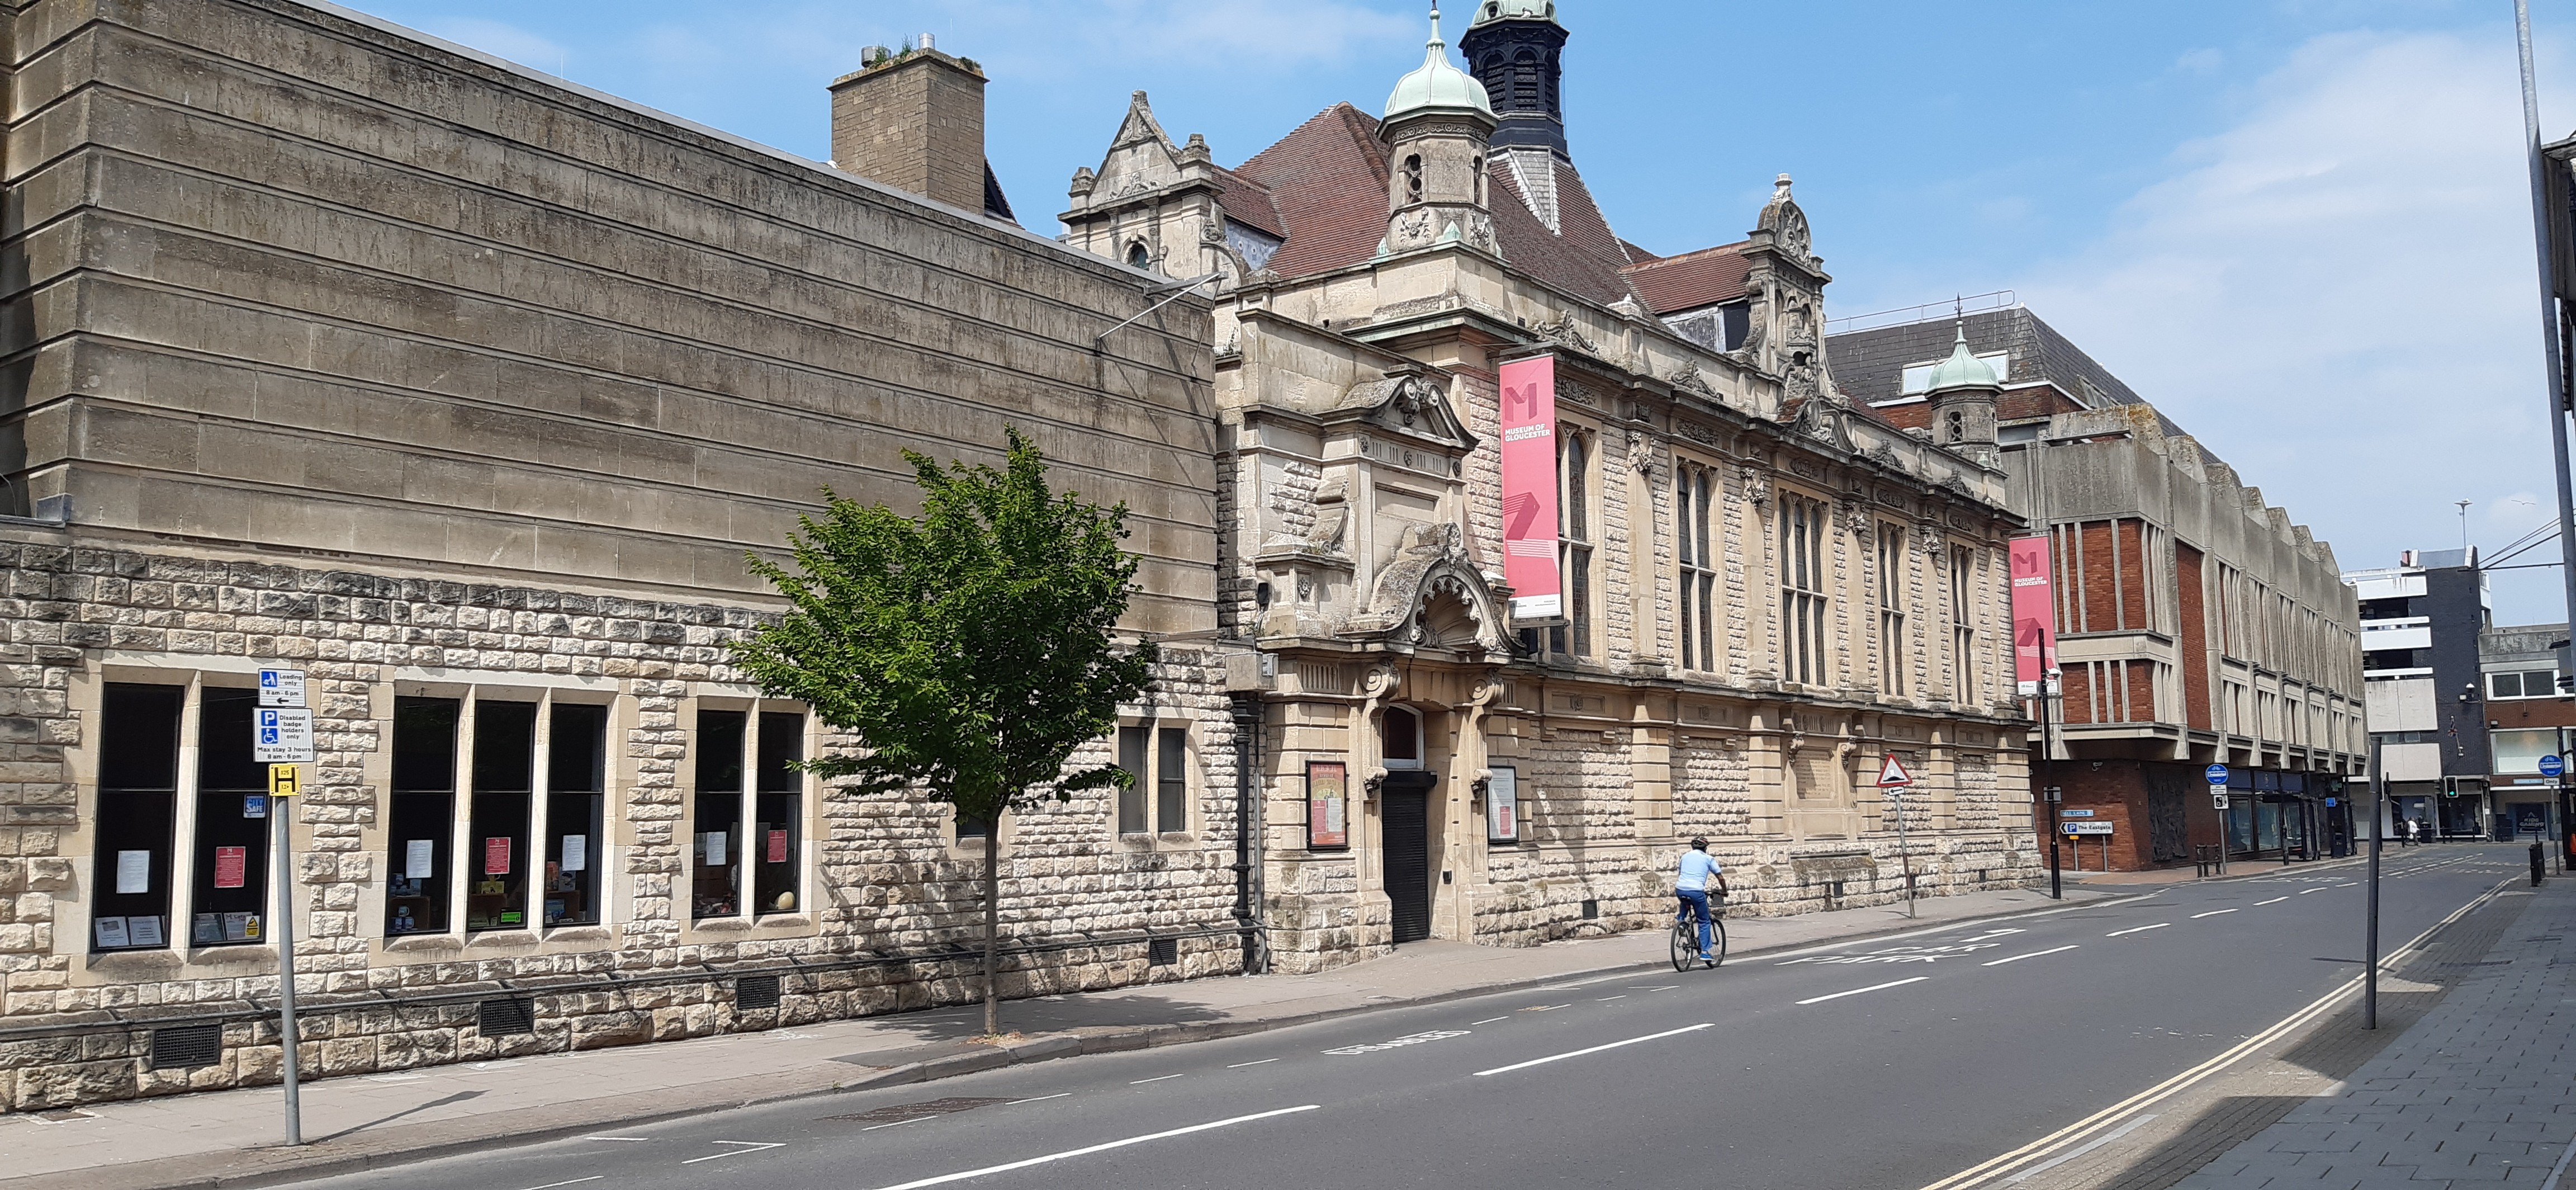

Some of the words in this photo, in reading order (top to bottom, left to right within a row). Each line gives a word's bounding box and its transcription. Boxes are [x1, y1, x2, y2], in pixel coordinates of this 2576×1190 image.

[1505, 425, 1534, 435] MUSEUM
[1505, 429, 1550, 442] GLOUCESTER
[274, 767, 296, 792] H
[246, 804, 263, 813] SAFE
[1867, 943, 2001, 955] CAR
[1774, 954, 1971, 965] PARK
[1324, 1031, 1471, 1055] DISABLED
